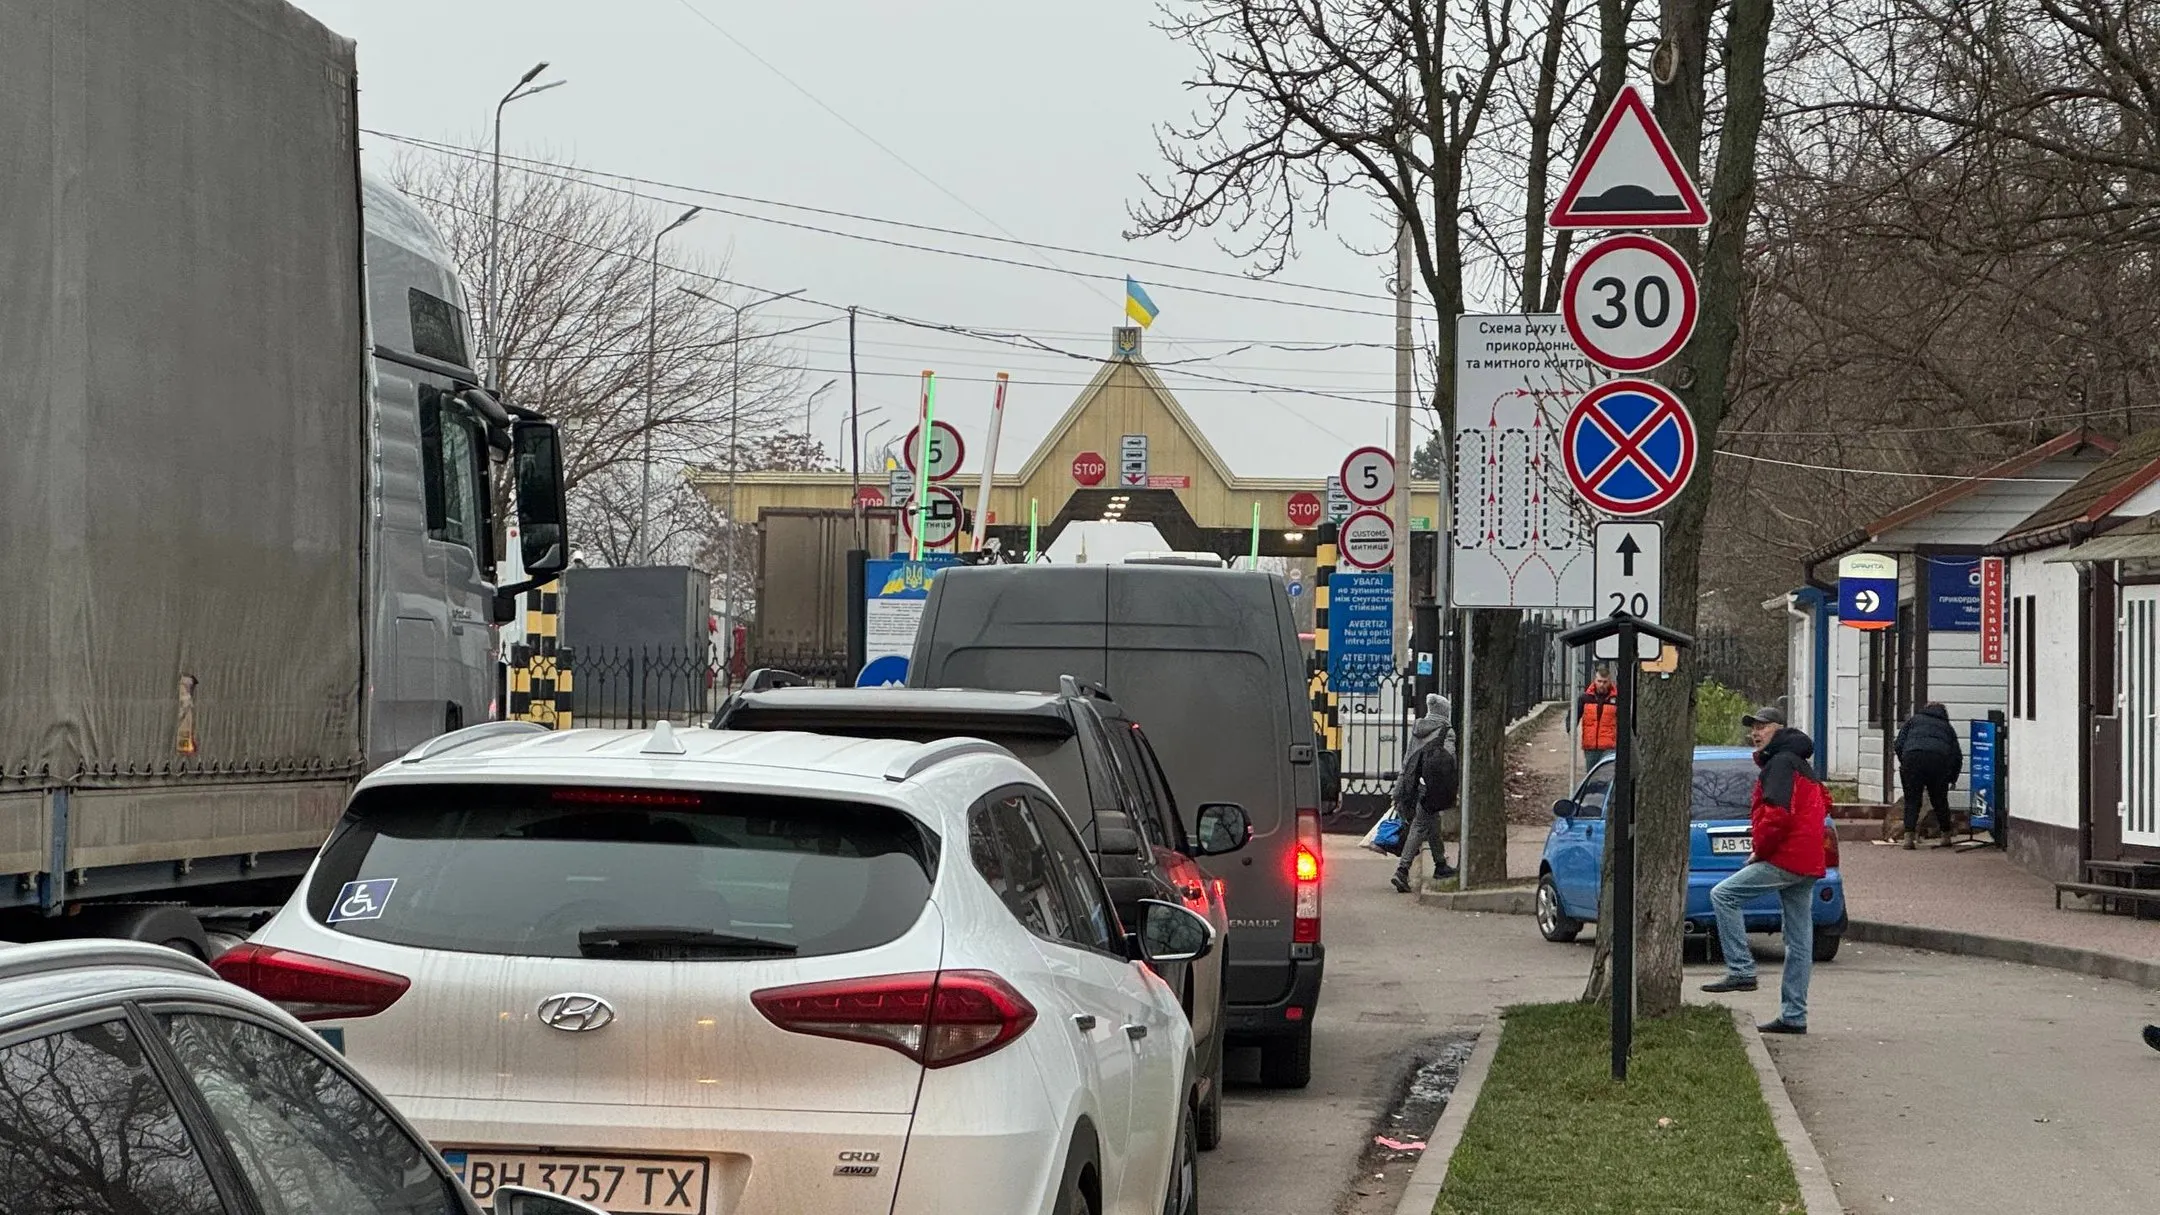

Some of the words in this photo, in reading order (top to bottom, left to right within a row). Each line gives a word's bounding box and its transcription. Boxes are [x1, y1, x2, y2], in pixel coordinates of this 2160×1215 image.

[1591, 275, 1670, 329] 30
[1479, 322, 1521, 334] Схема
[1526, 324, 1556, 336] руху
[1486, 341, 1577, 353] прикордонно
[1466, 359, 1480, 369] та
[1484, 359, 1540, 369] митного
[928, 440, 942, 463] 5
[1074, 463, 1104, 475] STOP
[1364, 466, 1378, 489] 5
[857, 498, 884, 508] TOP
[1289, 503, 1320, 516] STOP
[1353, 577, 1384, 586] УВАГА!
[1609, 592, 1648, 619] 20
[1721, 839, 1736, 851] AB
[1739, 839, 1752, 850] 13
[1228, 920, 1280, 929] ENAULT
[838, 1151, 880, 1162] CRDi
[839, 1166, 873, 1174] 4WD
[470, 1161, 526, 1199] BH
[538, 1163, 625, 1203] 3757
[636, 1167, 695, 1207] TX
